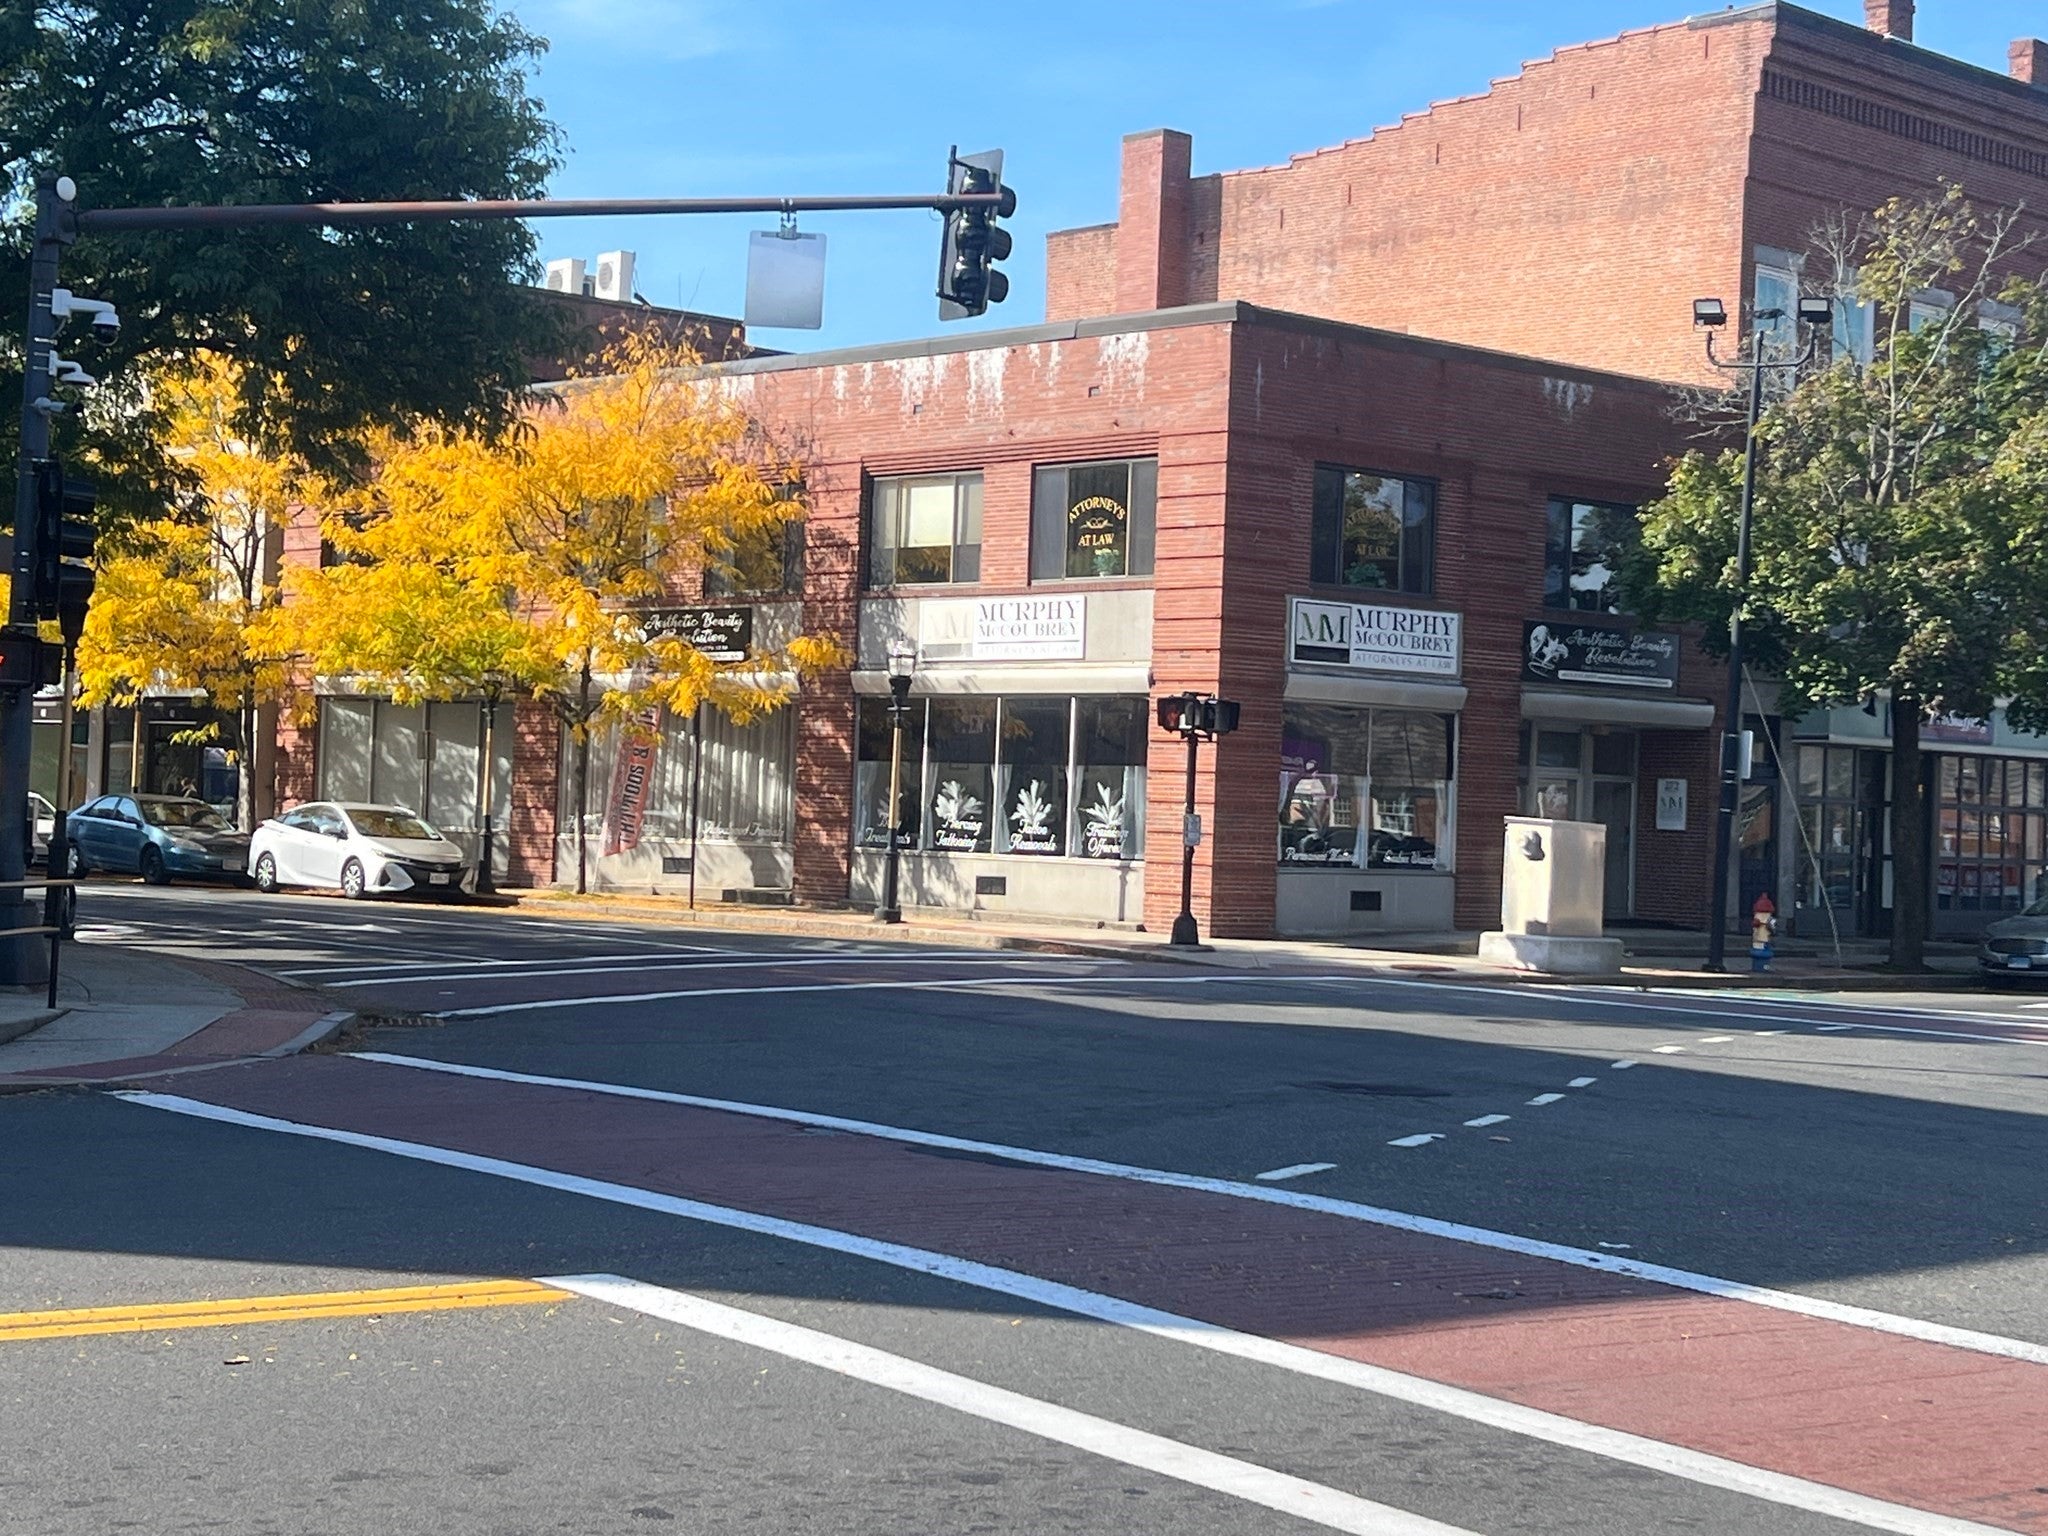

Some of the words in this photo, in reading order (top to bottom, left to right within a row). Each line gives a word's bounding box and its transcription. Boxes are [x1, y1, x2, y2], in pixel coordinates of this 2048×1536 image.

[1068, 496, 1126, 524] ATTORNEYS
[1078, 534, 1091, 546] AT
[1092, 533, 1114, 546] LAW
[701, 611, 744, 632] Beauty
[979, 600, 1080, 622] MURPHY
[1355, 608, 1455, 636] MURPHY
[1355, 651, 1412, 666] ATTORNEYS
